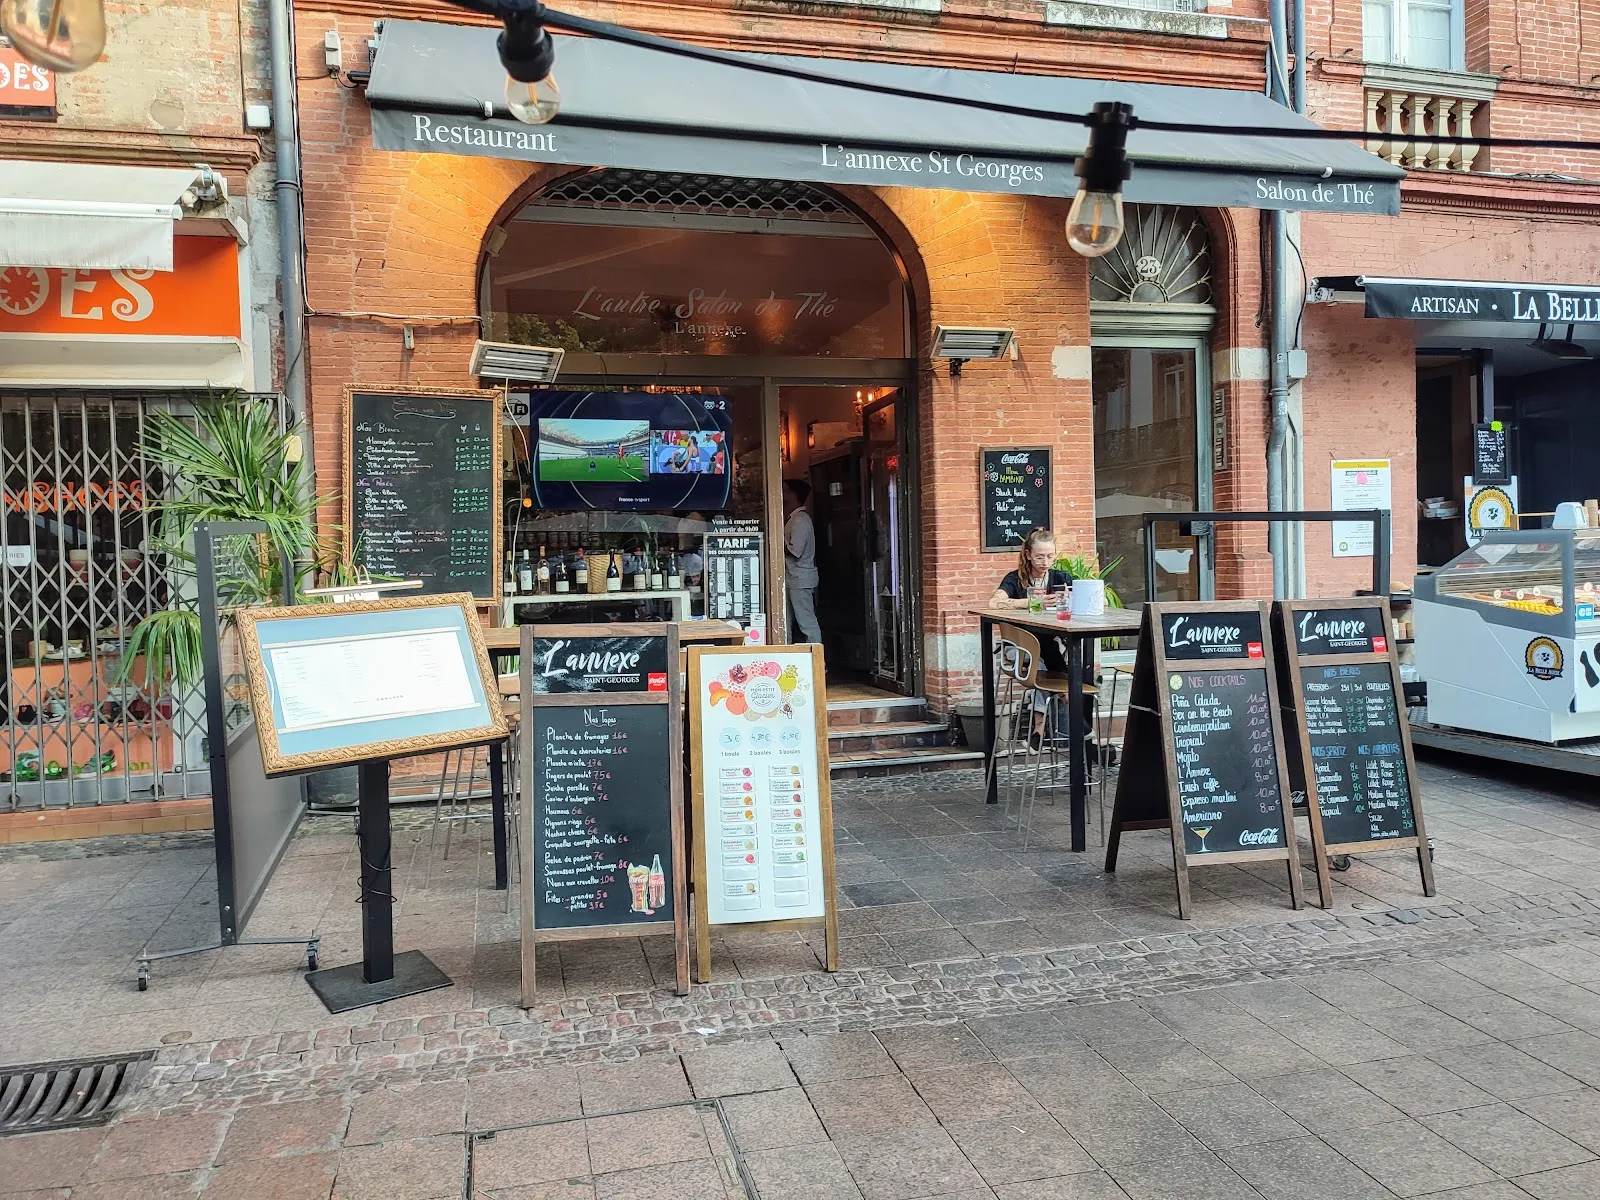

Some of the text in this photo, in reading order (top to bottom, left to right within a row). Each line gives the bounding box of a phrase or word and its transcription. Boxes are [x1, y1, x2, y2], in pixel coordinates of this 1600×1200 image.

[412, 114, 557, 151] Restaurant
[820, 144, 1044, 186] L'annexe St Georges
[1256, 178, 1374, 204] Salon de Thé
[1140, 259, 1156, 273] 23
[572, 286, 838, 320] L'autre Salon de Thé
[1411, 297, 1479, 313] ARTISAN
[1513, 291, 1540, 320] LA
[717, 538, 750, 549] TARIF
[1169, 617, 1240, 647] L'annexe
[1299, 612, 1365, 642] L'annexe
[541, 640, 640, 677] L'annexe
[1324, 669, 1337, 678] NOS
[1188, 674, 1246, 688] NOS COCKTAILS
[1171, 693, 1189, 707] Piña
[584, 709, 617, 725] Nos Tapas
[1172, 705, 1232, 720] Sex on the Beach
[546, 727, 573, 741] Planche
[584, 731, 609, 744] fromages
[1174, 732, 1205, 753] Tropical
[546, 743, 569, 755] Planche
[1312, 746, 1325, 756] NOS
[1358, 746, 1370, 755] NOS
[546, 757, 567, 767] Planche
[1176, 748, 1200, 768] Mojito
[574, 770, 591, 782] poulet
[1179, 779, 1199, 793] Irish
[1211, 790, 1237, 803] martini
[545, 805, 569, 815] Houmous
[1183, 810, 1222, 823] Americano
[568, 819, 582, 828] rings
[1239, 828, 1279, 845] Coca-Cola
